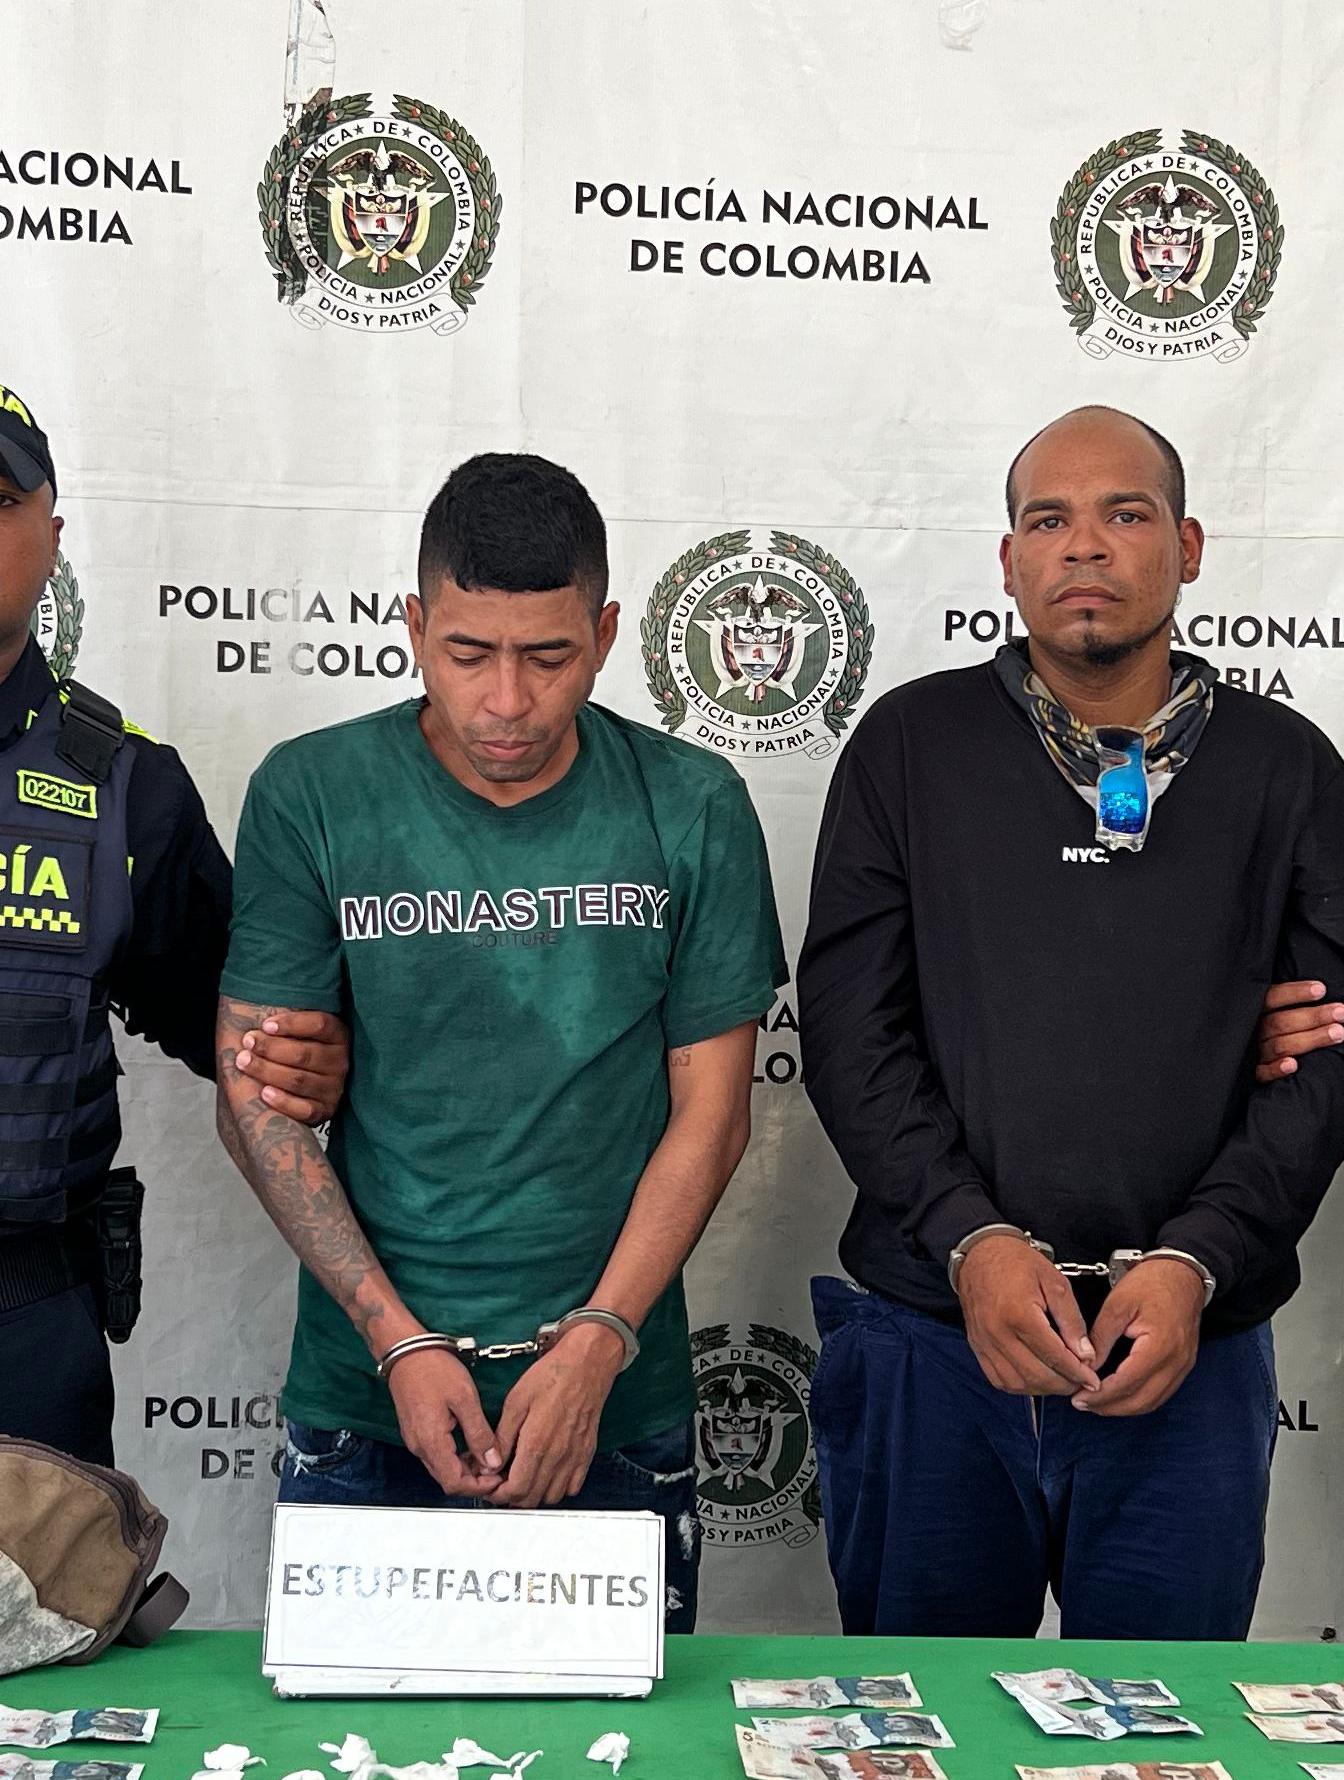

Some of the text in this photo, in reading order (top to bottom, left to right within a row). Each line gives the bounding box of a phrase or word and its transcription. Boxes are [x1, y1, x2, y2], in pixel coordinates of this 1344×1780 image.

[575, 178, 989, 231] POLICÍA NACIONAL
[1162, 156, 1186, 169] DE
[1204, 168, 1254, 261] COLOMBIA
[630, 239, 931, 284] DE COLOMBIA
[1165, 281, 1245, 333] NACIONAL
[1105, 326, 1224, 356] DIOS Y PATRIA
[751, 556, 775, 569] DE
[794, 569, 843, 660] COLOMBIA
[216, 640, 419, 679] DE COLO
[756, 680, 836, 730] NACIONAL
[697, 725, 815, 753] DIOS Y PATRIA
[25, 778, 88, 808] 022107
[1062, 847, 1110, 863] NYC.
[340, 883, 671, 941] MONASTERY
[472, 930, 558, 949] COUTURE
[201, 1448, 255, 1480] DE
[282, 1562, 650, 1608] ESTUPEFACIENTES
